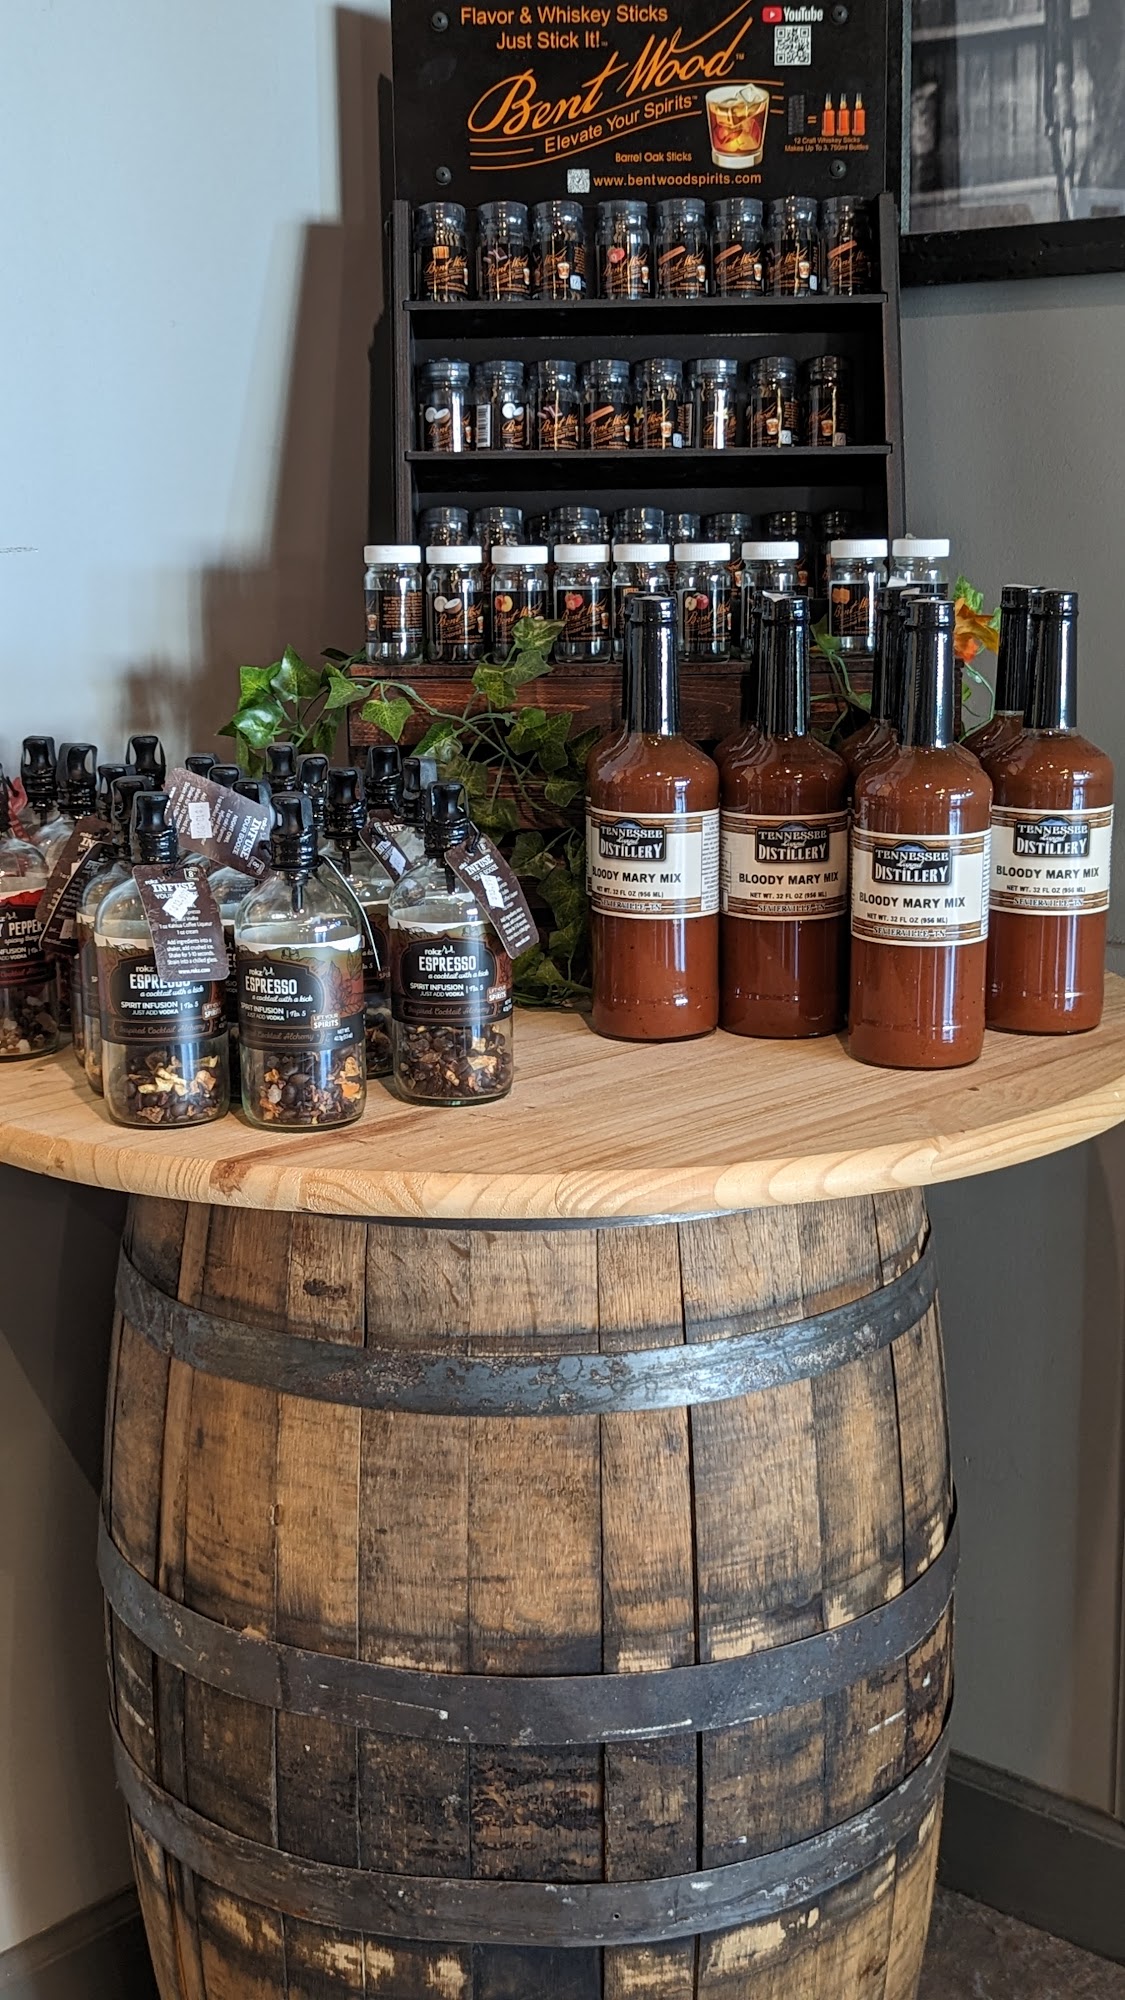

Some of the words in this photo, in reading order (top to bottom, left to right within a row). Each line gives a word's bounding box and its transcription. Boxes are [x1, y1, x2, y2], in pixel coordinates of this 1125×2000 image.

[460, 6, 514, 25] Flavor
[519, 6, 532, 24] &
[537, 5, 611, 27] Whiskey
[616, 4, 668, 22] Sticks
[783, 6, 823, 22] YouTube
[496, 32, 532, 49] Just
[537, 31, 579, 48] Stick
[585, 30, 600, 48] It!
[467, 50, 629, 135] Bent
[616, 0, 752, 98] Wood
[545, 123, 603, 154] Elevate
[607, 109, 641, 132] Your
[643, 95, 692, 119] Spirits
[615, 152, 642, 163] Barrel
[644, 152, 665, 163] Oak
[666, 151, 692, 162] Sticks
[593, 173, 762, 187] www.bentwoodspirits.com
[230, 814, 239, 831] NIGHT
[242, 815, 252, 834] YOUR
[1017, 825, 1088, 835] TENNESSEE
[240, 818, 261, 860] INFUSE
[601, 826, 663, 839] TENNESSEE
[758, 830, 827, 840] TENNESSEE
[232, 832, 244, 855] BOOZE
[601, 839, 662, 859] DISTILLERY
[758, 843, 826, 860] DISTILLERY
[1017, 837, 1087, 855] DISTILLERY
[875, 849, 949, 861] TENNESSEE
[465, 854, 494, 876] INFUSE
[875, 863, 948, 882] DISTILLERY
[996, 865, 1042, 879] BLOODY
[1046, 869, 1080, 879] MARY
[1083, 867, 1099, 878] MIX
[622, 873, 656, 883] MARY
[660, 873, 681, 883] MIX
[739, 873, 784, 885] BLOODY
[788, 874, 821, 885] MARY
[824, 872, 839, 883] MIX
[152, 882, 197, 893] INFUSE
[859, 892, 899, 907] BLOODY
[903, 898, 940, 908] MARY
[945, 897, 966, 908] MIX
[424, 948, 442, 956] rokz
[136, 965, 154, 973] rokz
[418, 955, 477, 972] ESPRESSO
[245, 976, 297, 995] ESPRESSO
[410, 982, 429, 990] SPIRIT
[142, 1001, 178, 1009] INFUSION
[240, 1002, 253, 1011] SPIRIT
[253, 1005, 284, 1015] INFUSION
[313, 1019, 339, 1029] SPIRITS
